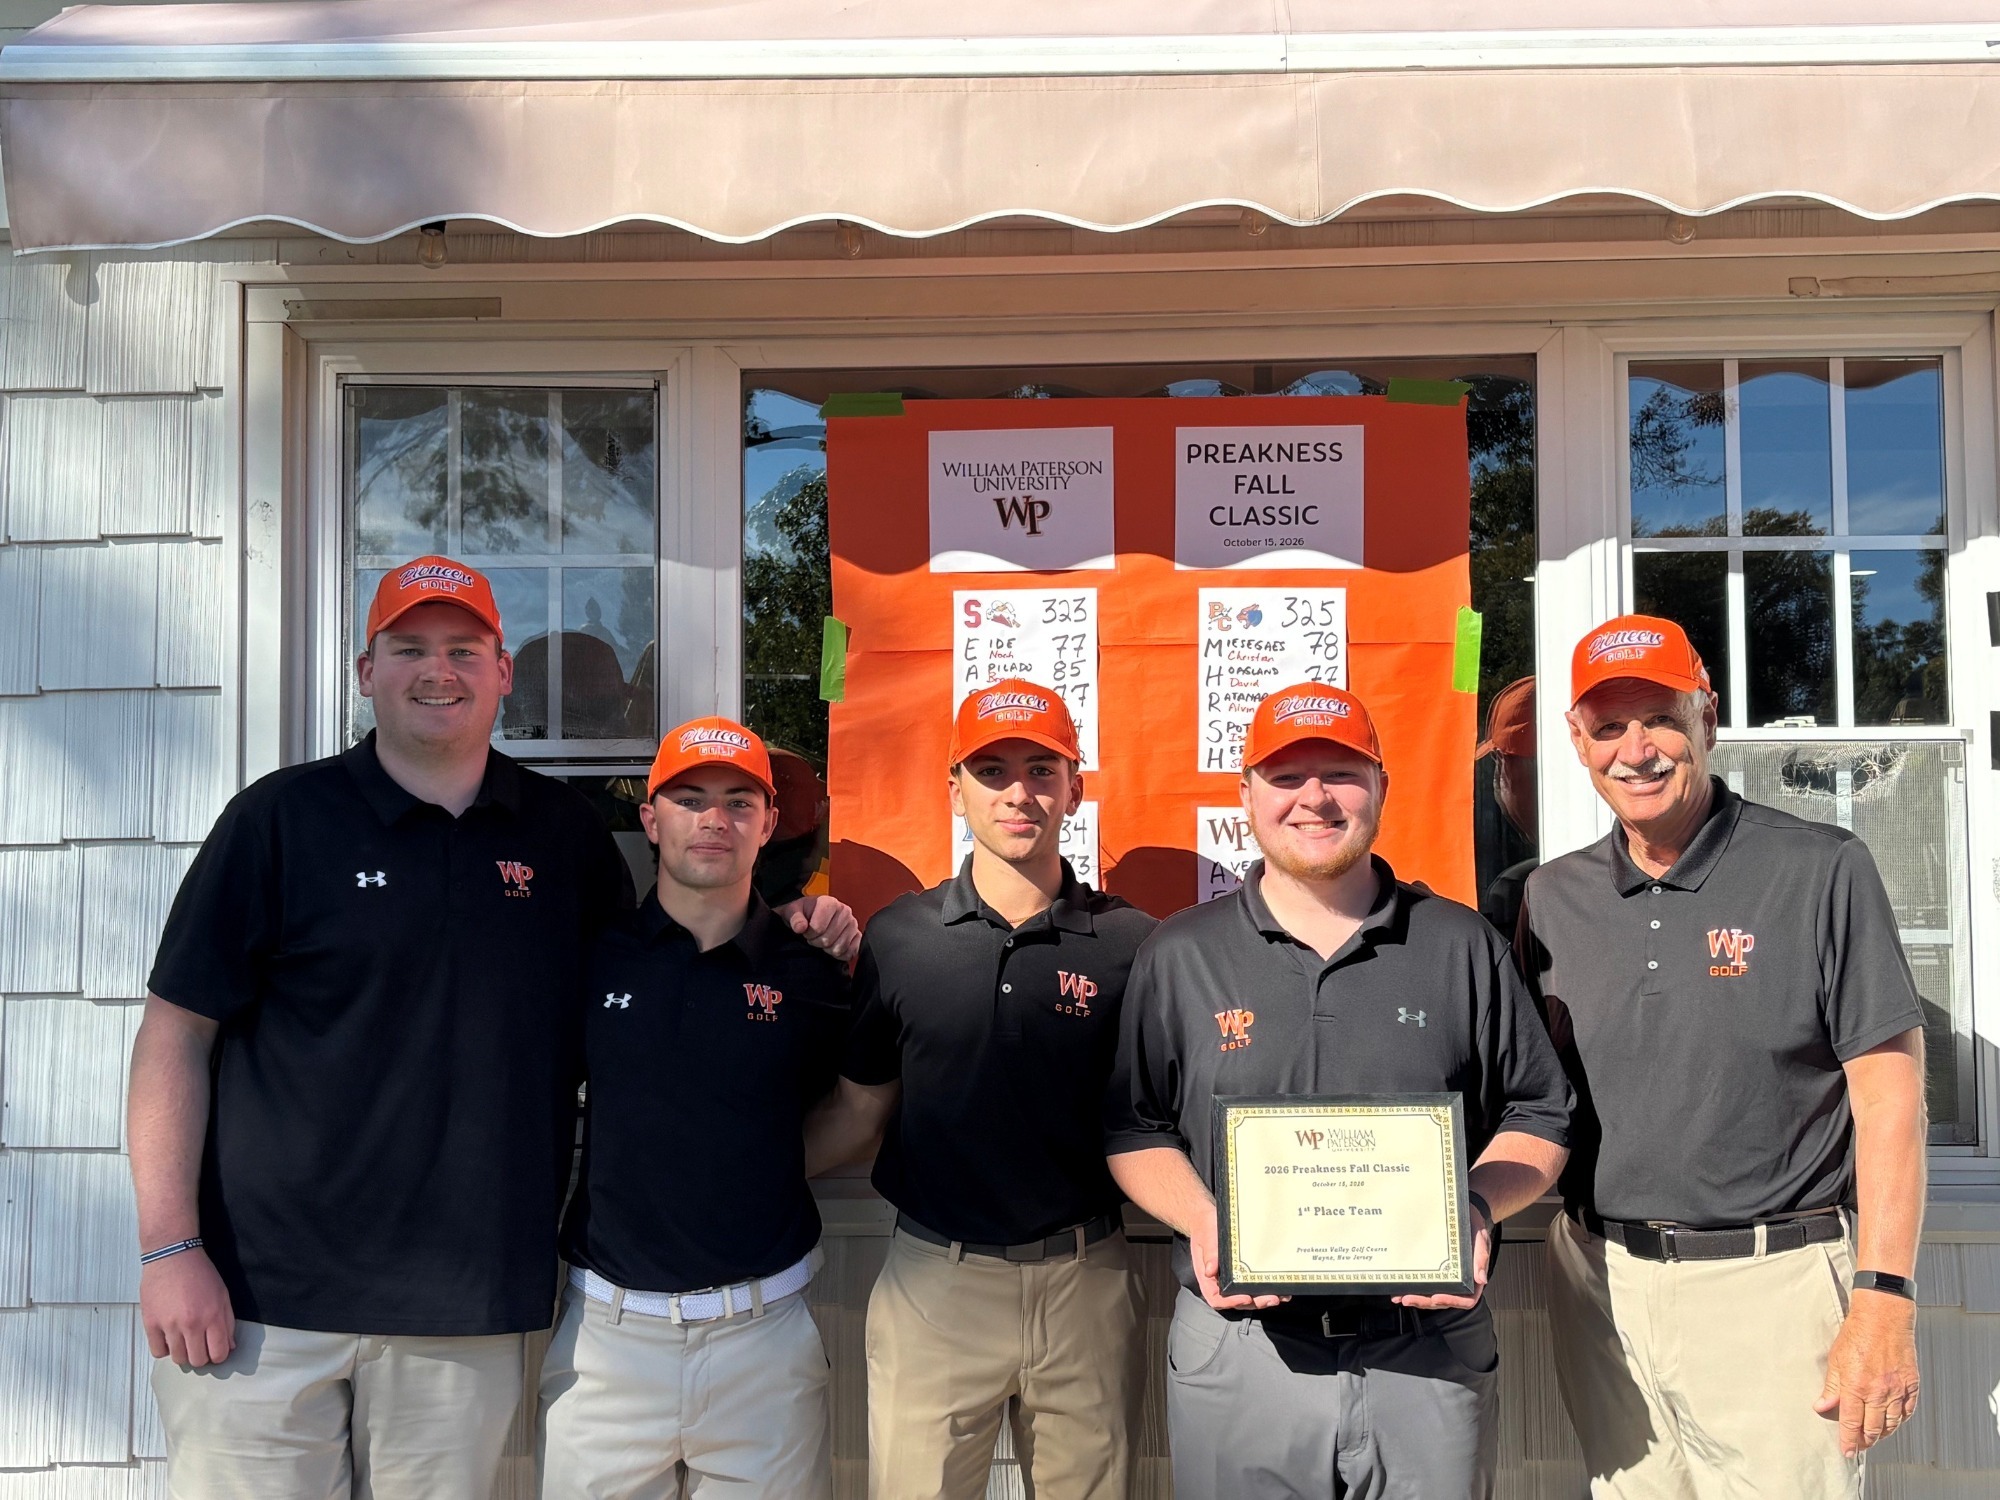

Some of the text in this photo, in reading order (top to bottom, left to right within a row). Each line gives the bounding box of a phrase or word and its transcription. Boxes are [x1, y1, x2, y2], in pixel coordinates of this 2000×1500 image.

[1187, 442, 1343, 464] PREAKNESS
[942, 460, 1103, 478] WILLIAM PATERSON
[973, 475, 1071, 493] UNIVERSITY
[1234, 474, 1296, 494] FALL
[993, 495, 1051, 536] WP
[1209, 505, 1320, 526] CLASSIC
[1223, 537, 1305, 547] October 15, 2026
[399, 564, 474, 589] Pioneers
[420, 580, 458, 593] GOLF
[1042, 597, 1087, 624] 323
[1281, 597, 1335, 628] 325
[1052, 633, 1087, 659] 77
[1303, 631, 1339, 660] 78
[1588, 630, 1664, 662] Pioneers
[1605, 649, 1646, 662] GOLF
[1053, 659, 1087, 682] 85
[1230, 677, 1260, 687] David
[977, 692, 1049, 718] Pioneers
[1273, 696, 1351, 724] Pioneers
[995, 710, 1034, 722] GOLF
[1294, 715, 1334, 726] GOLF
[1206, 816, 1253, 851] WP
[496, 861, 533, 890] WP
[504, 889, 532, 898] GOLF
[1707, 928, 1754, 965] WP
[1709, 965, 1749, 977] GOLF
[743, 983, 783, 1014] WP
[1057, 970, 1098, 1008] WP
[747, 1012, 779, 1022] GOLF
[1055, 1003, 1091, 1017] GOLF
[1215, 1008, 1255, 1040] WP
[1220, 1038, 1252, 1052] GOLF
[1294, 1129, 1324, 1150] WP
[1327, 1128, 1375, 1140] WILLIAM
[1327, 1138, 1376, 1149] PATERSON
[1264, 1163, 1410, 1174] 2026 Preakness Fall Classic
[1314, 1206, 1346, 1216] Place
[1348, 1206, 1382, 1216] Team
[1330, 1246, 1349, 1254] Valley
[1352, 1254, 1373, 1262] Jersey
